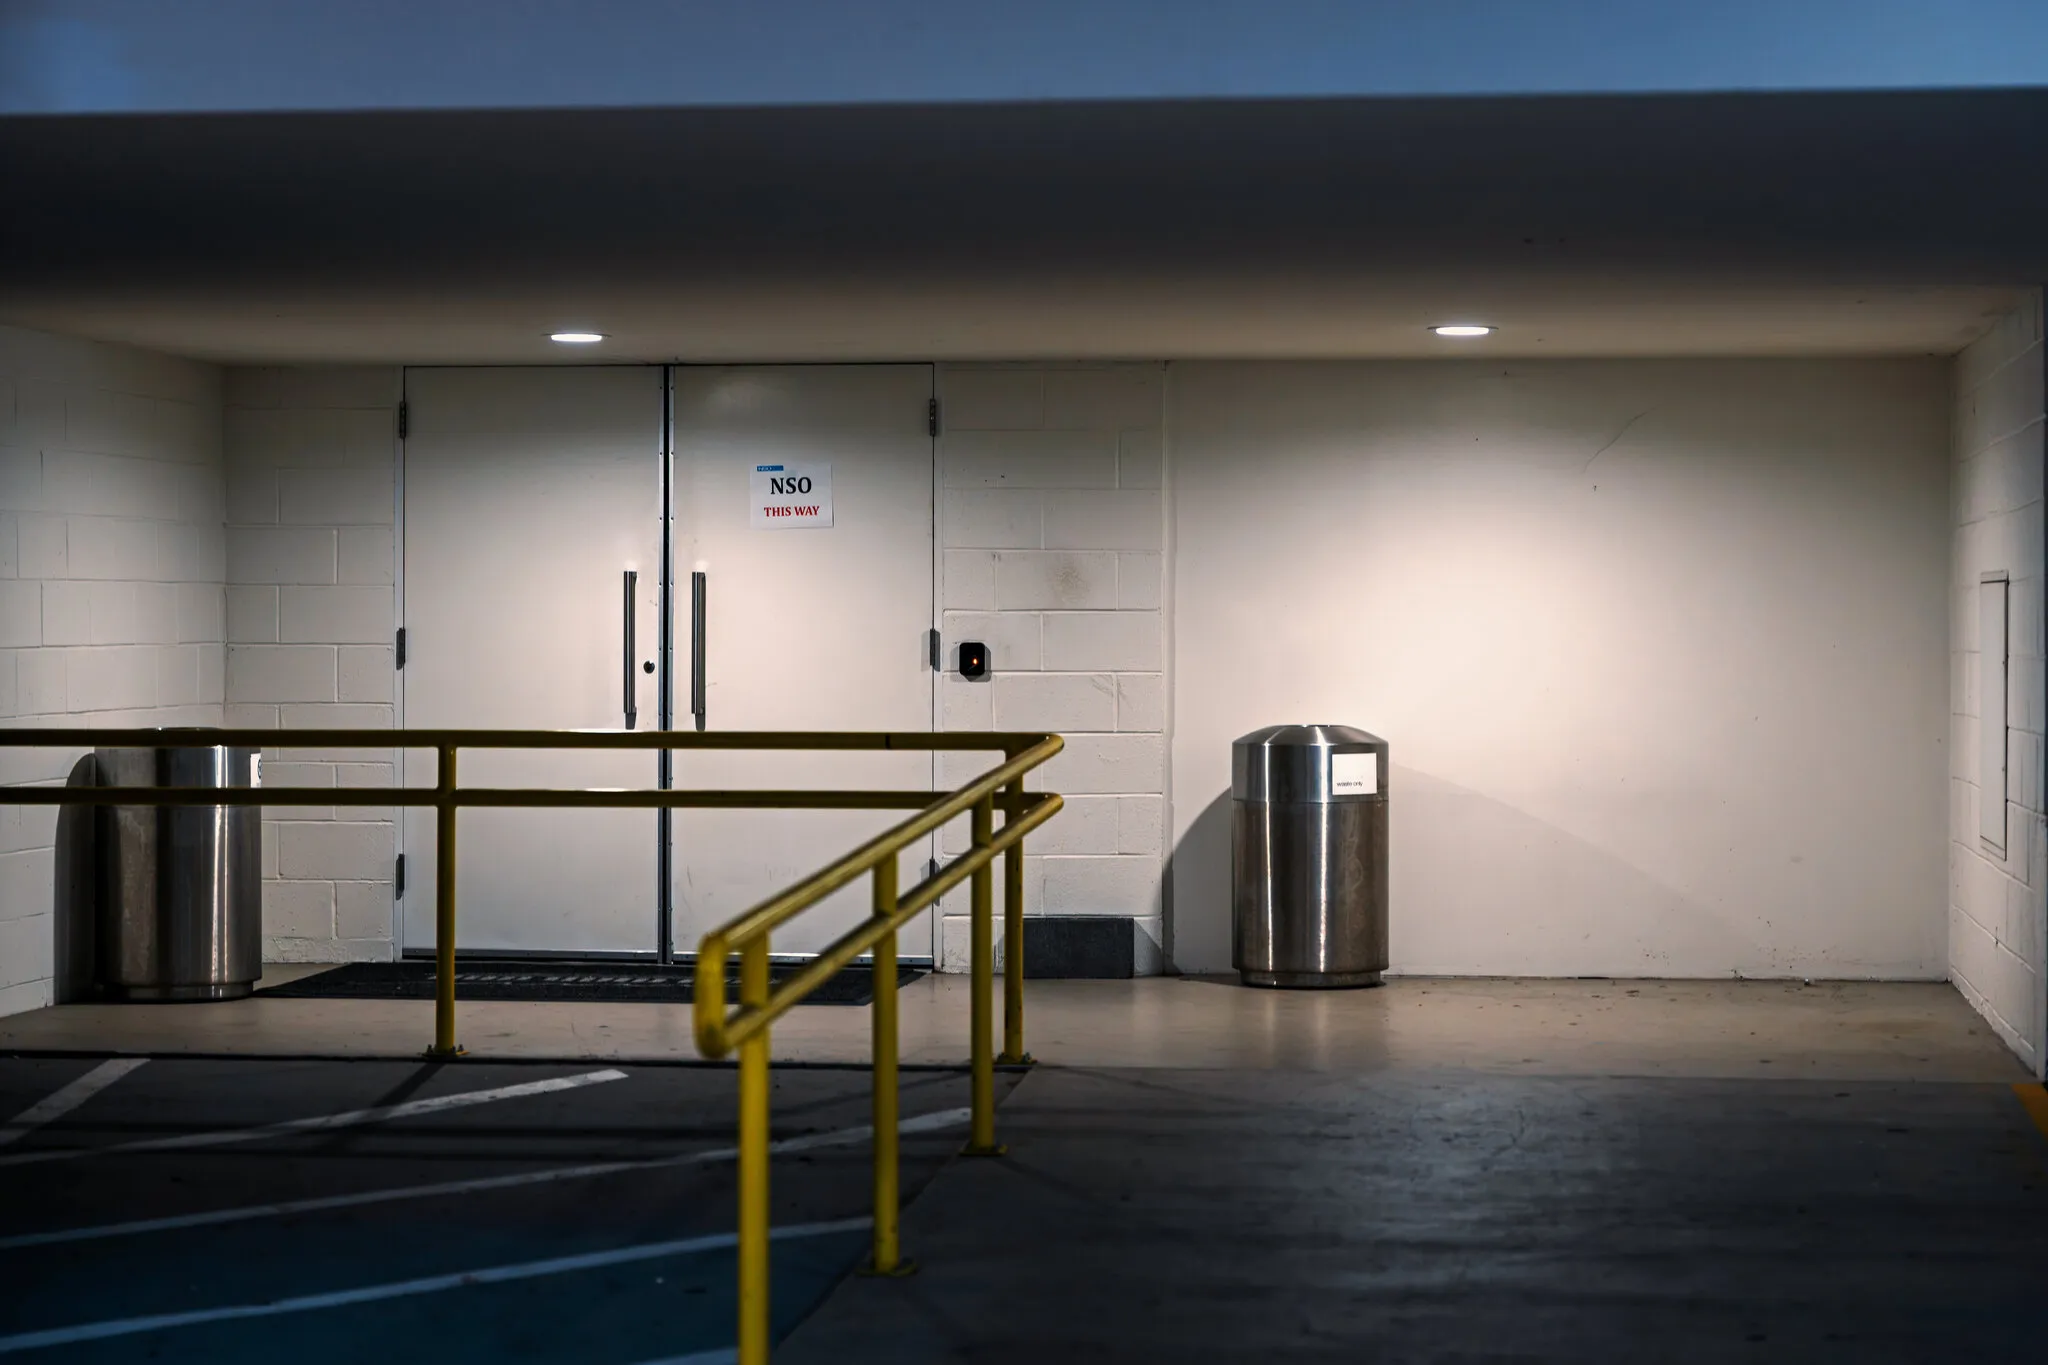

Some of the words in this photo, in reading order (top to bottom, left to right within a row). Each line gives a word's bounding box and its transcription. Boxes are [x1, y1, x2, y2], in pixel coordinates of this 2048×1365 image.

[770, 476, 812, 495] NSO
[763, 506, 792, 517] THIS
[794, 505, 820, 516] WAY
